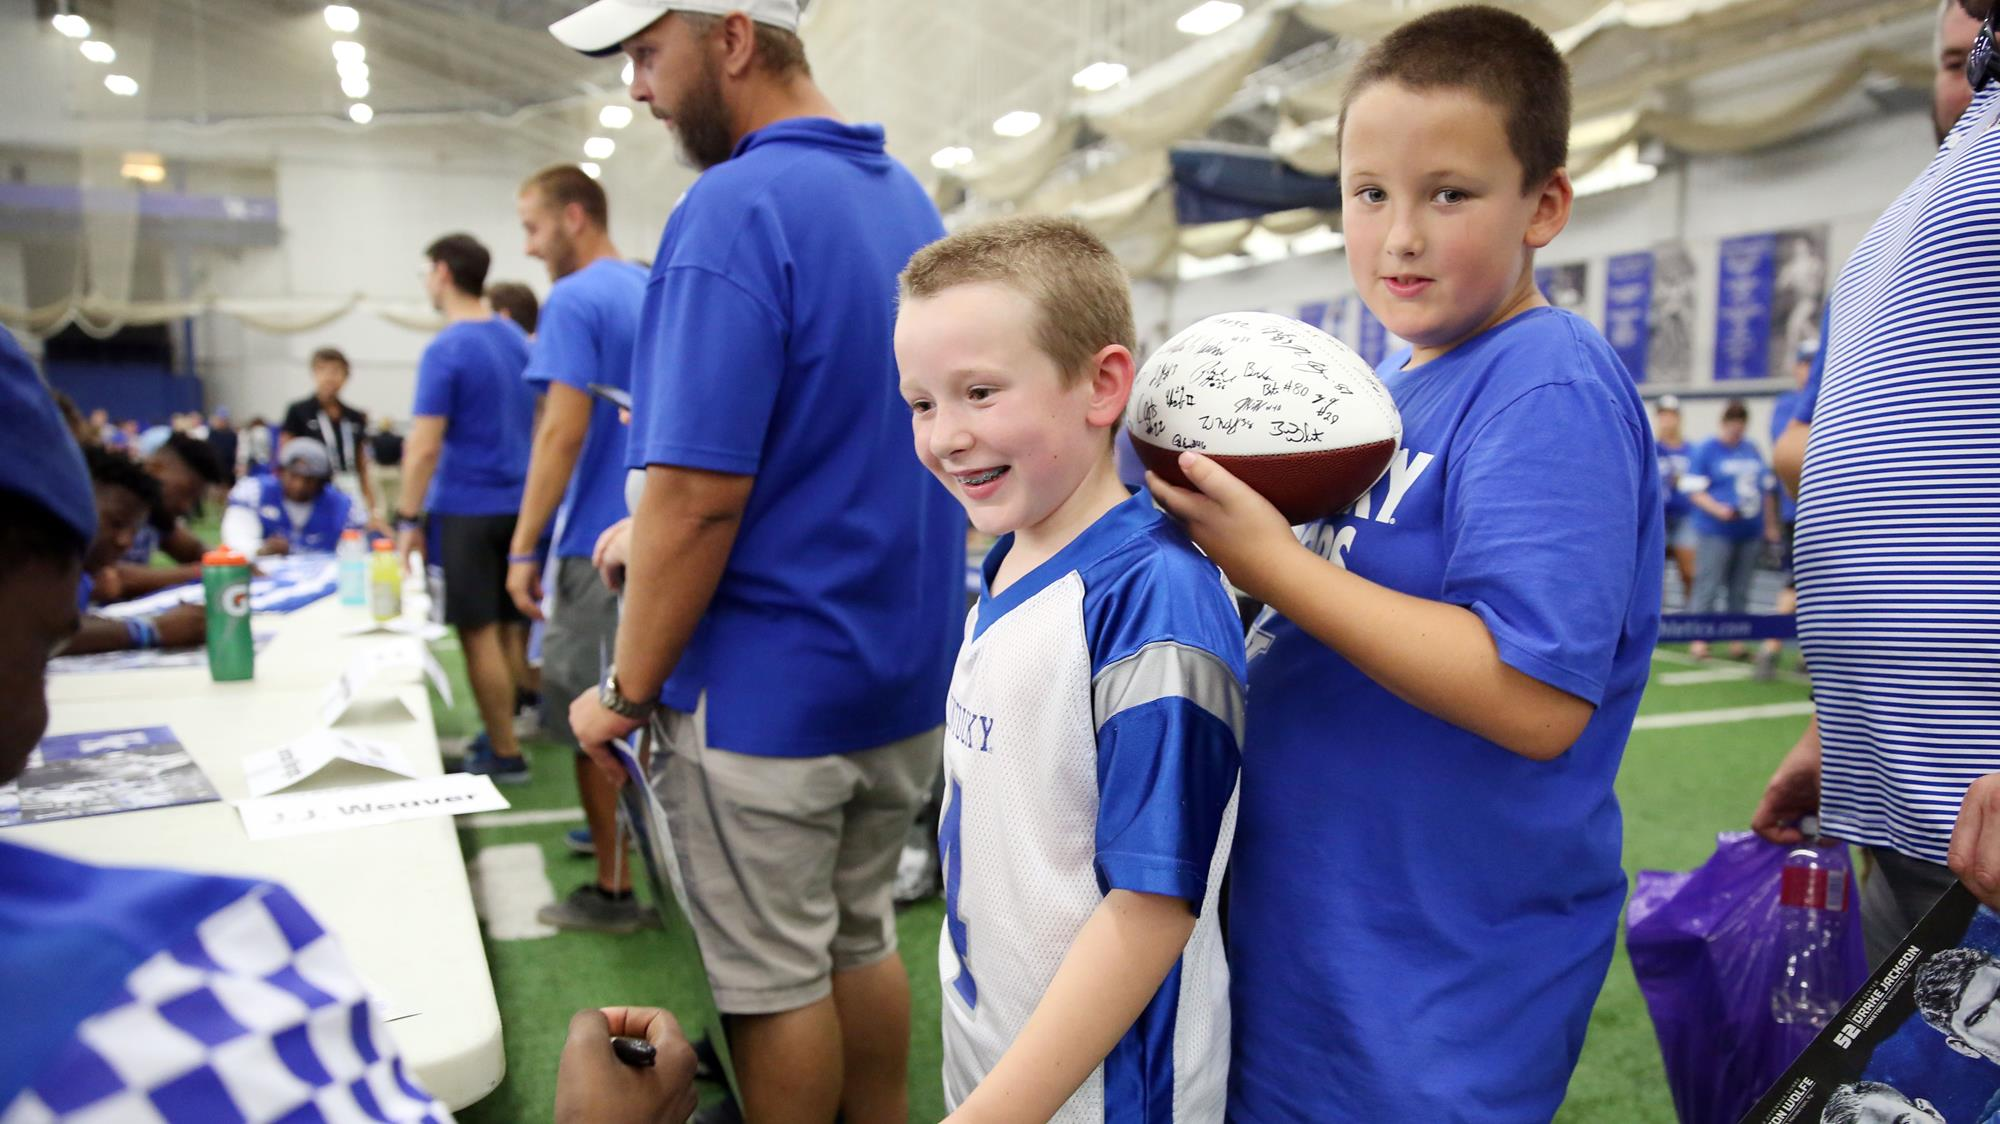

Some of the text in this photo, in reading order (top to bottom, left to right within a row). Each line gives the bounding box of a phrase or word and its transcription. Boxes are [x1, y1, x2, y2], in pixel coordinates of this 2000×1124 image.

[1283, 380, 1309, 396] #80
[222, 584, 250, 617] G
[336, 792, 478, 816] Weaver
[1851, 944, 1921, 1025] DRAKE JACKSON
[1833, 1023, 1862, 1050] 52
[1781, 1076, 1814, 1112] WOLFE
